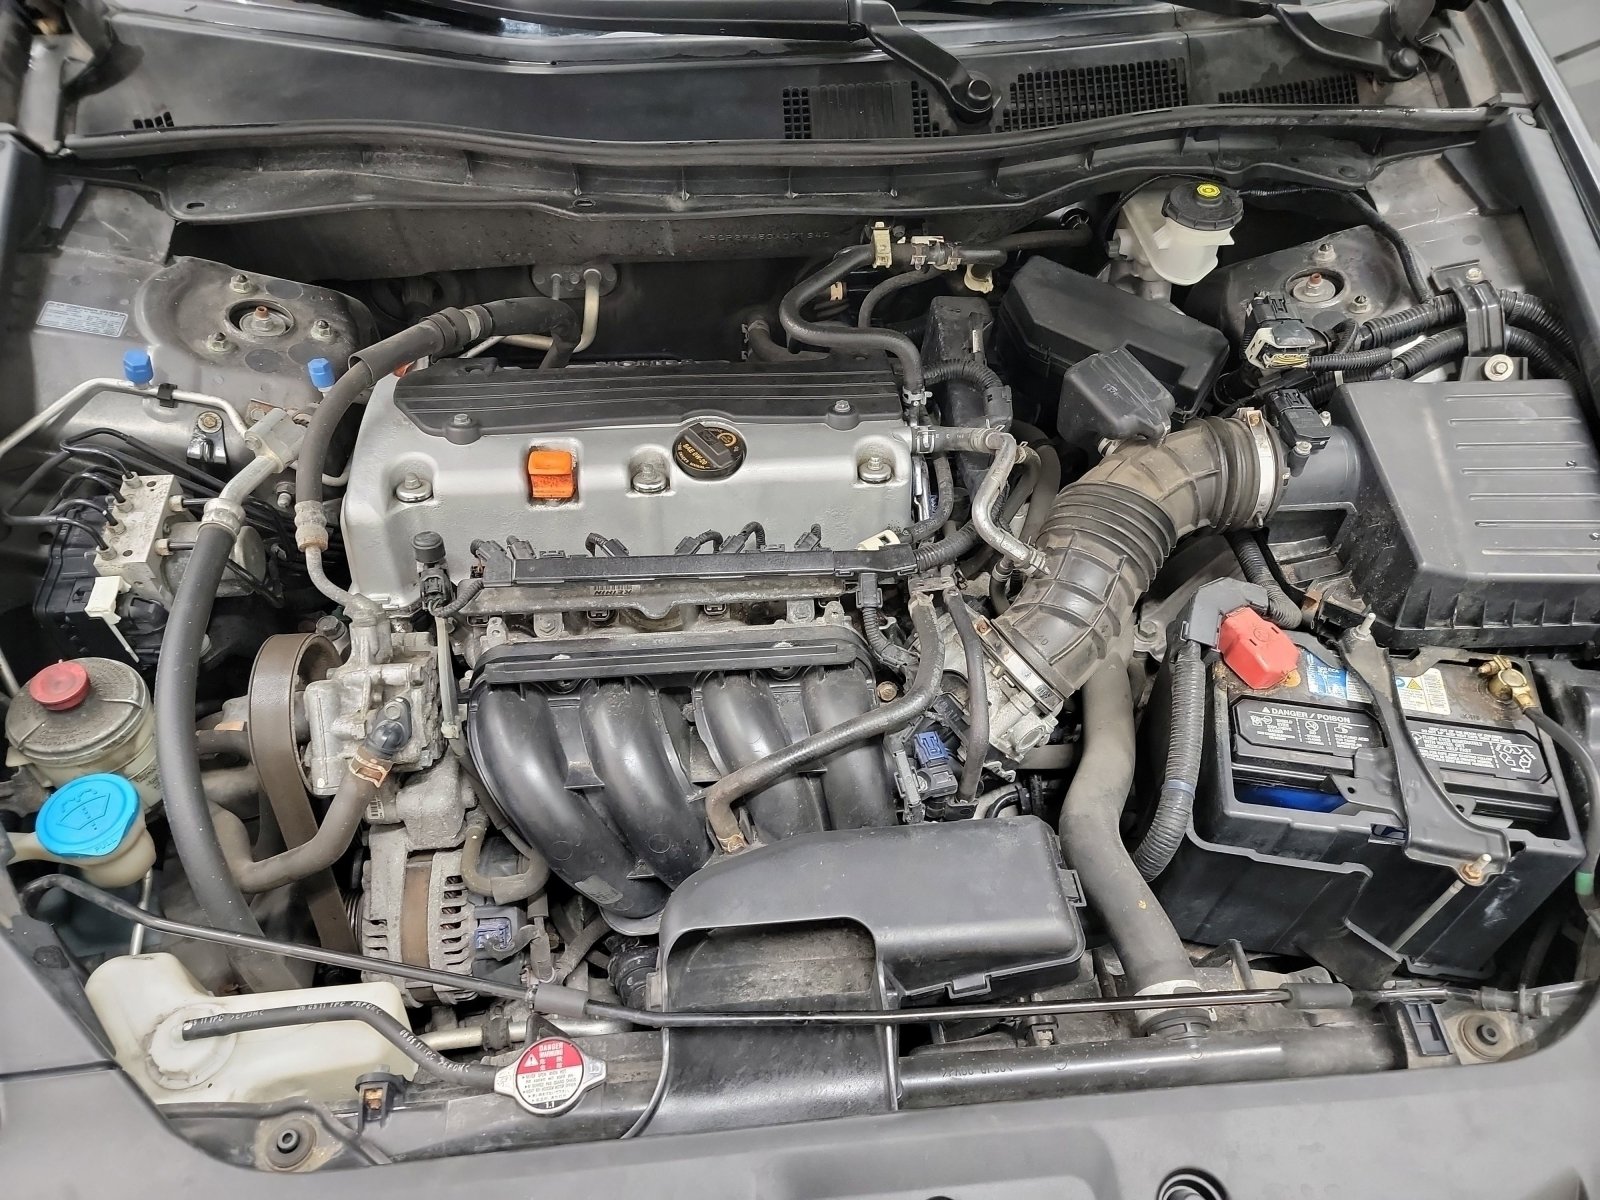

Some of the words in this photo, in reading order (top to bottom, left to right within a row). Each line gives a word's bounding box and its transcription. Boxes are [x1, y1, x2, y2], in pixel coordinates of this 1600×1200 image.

[682, 444, 694, 454] SAE
[1272, 708, 1308, 718] DANGER
[1317, 714, 1351, 723] POISON
[540, 1042, 564, 1051] DANGER
